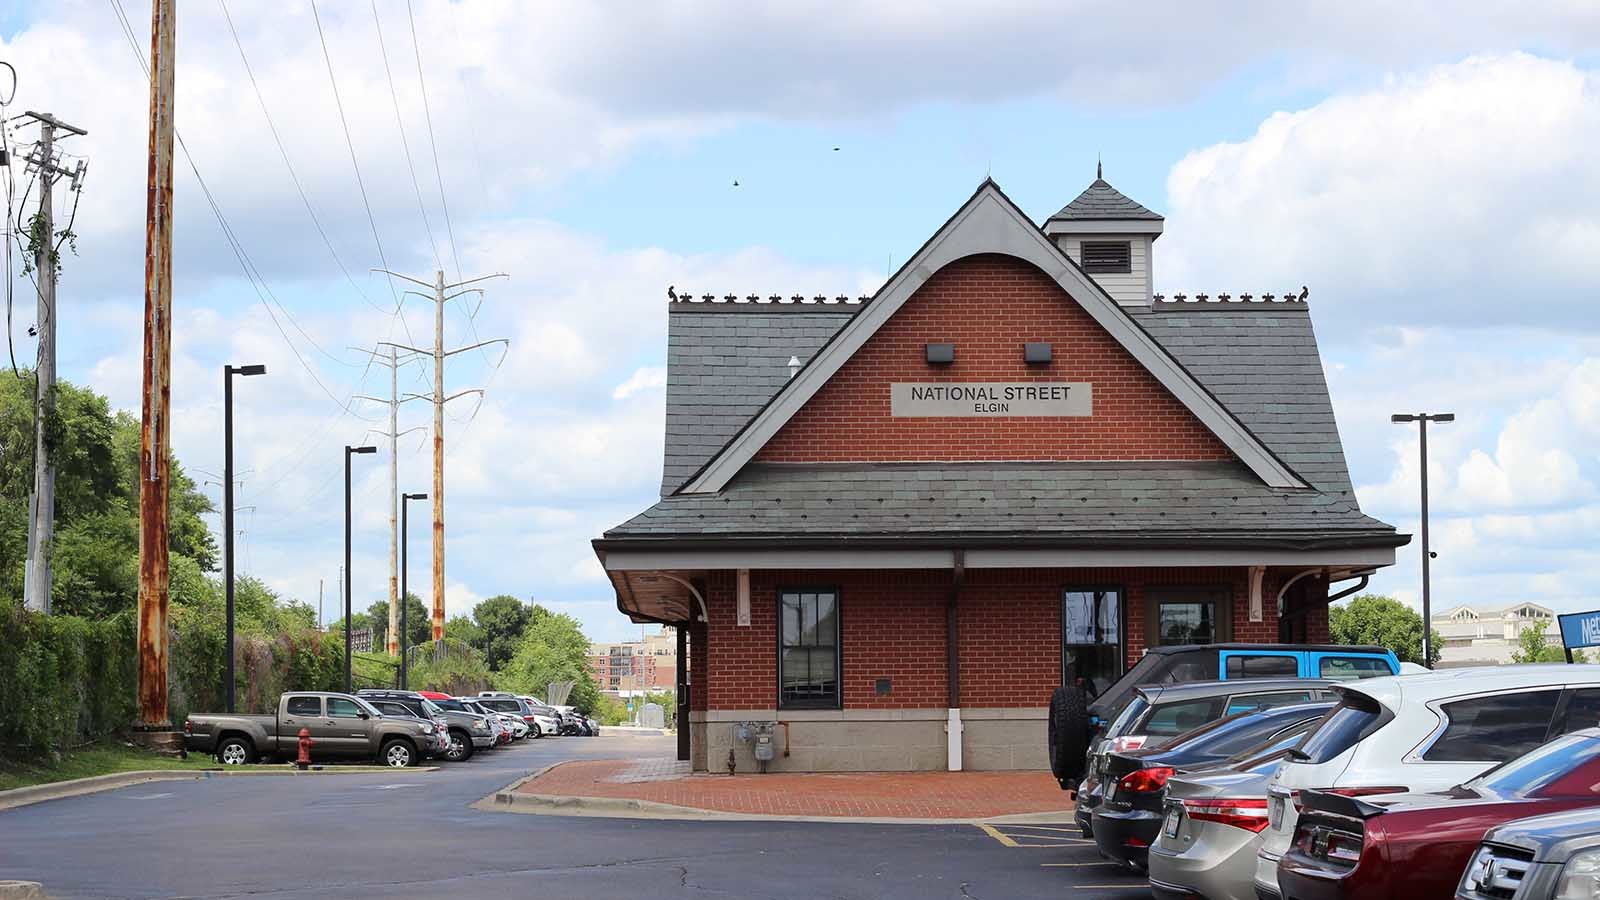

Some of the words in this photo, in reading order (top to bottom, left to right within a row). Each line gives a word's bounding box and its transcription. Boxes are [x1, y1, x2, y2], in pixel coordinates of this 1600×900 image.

[911, 386, 999, 401] NATIONAL
[1004, 386, 1071, 400] STREET
[974, 403, 1009, 413] ELGIN
